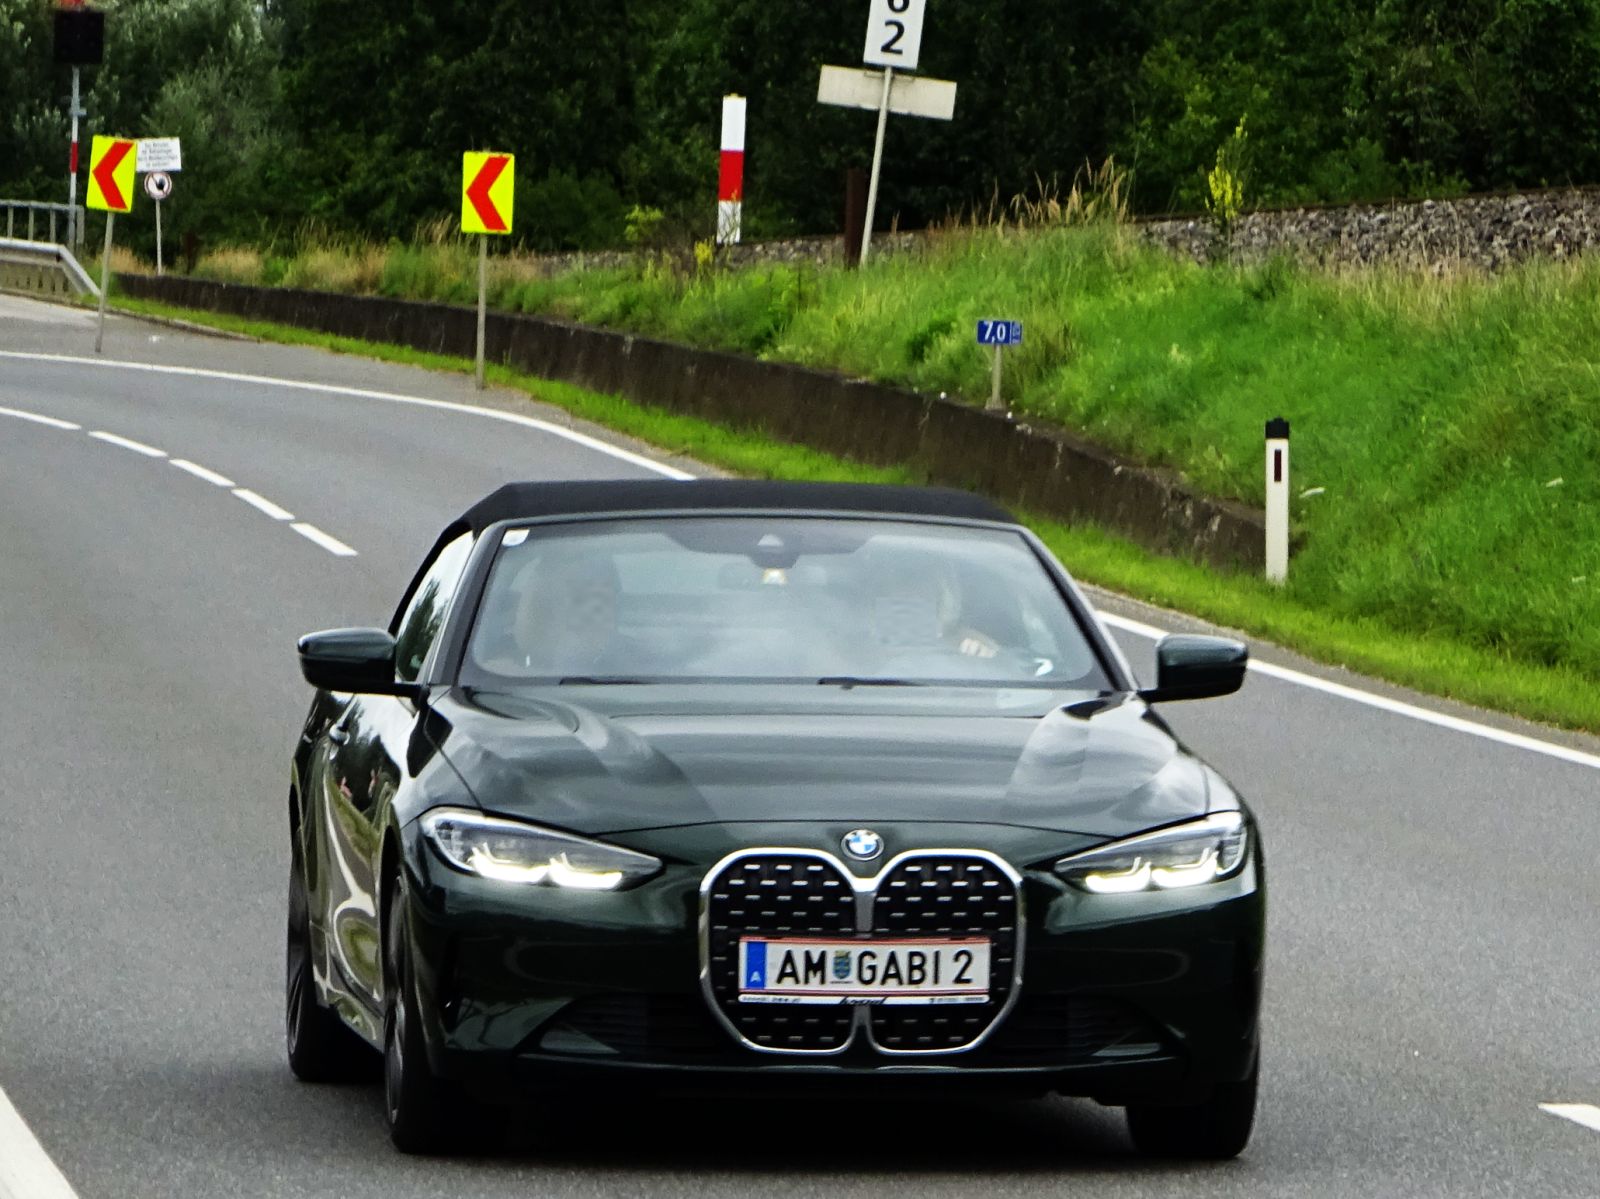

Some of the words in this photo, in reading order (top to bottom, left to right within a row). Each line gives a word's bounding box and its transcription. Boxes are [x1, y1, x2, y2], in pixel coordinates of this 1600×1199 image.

[881, 20, 905, 55] 2
[750, 971, 761, 982] A
[776, 950, 826, 985] AM
[857, 950, 941, 986] GABI
[953, 950, 973, 984] 2
